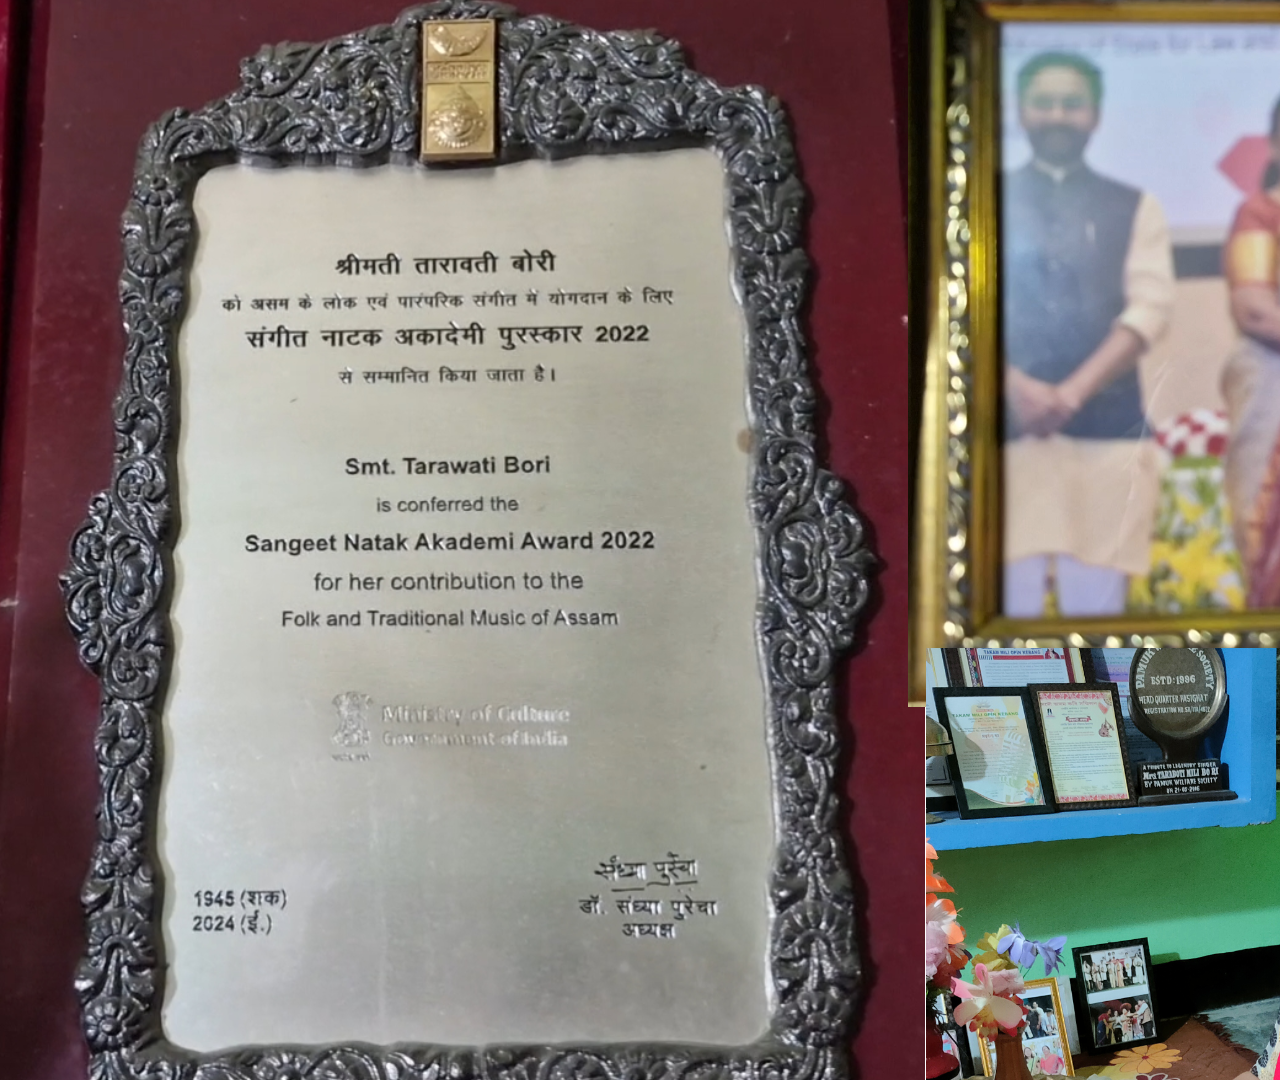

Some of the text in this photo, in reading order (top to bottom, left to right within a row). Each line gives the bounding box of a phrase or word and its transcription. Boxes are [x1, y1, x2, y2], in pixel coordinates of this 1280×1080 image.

[335, 248, 557, 275] श्रीमती तारावती बोरी
[222, 286, 674, 312] को असम के लोक एवं पारंपरिक संगीत में योगदान के लिए
[245, 321, 650, 350] संगीत नाटक अकादेमी पुरस्कार 2022
[339, 367, 353, 384] से
[363, 366, 430, 385] सम्मानित
[439, 365, 477, 383] किया
[487, 368, 525, 384] जाता
[345, 455, 550, 476] Smt. Tarawati Bori
[376, 496, 519, 513] is conferred the
[245, 530, 655, 556] Sangeet Natak Akademi Award 2022
[314, 571, 584, 591] for her contribution to the
[282, 608, 619, 627] Folk and Traditional Music of Assam
[1135, 648, 1157, 690] PAMUK
[1195, 649, 1215, 691] SOCIETY
[382, 704, 571, 726] Ministry of Culture
[382, 730, 569, 748] Government of India
[194, 889, 287, 910] 1945 (शक)
[616, 895, 663, 916] संध्या
[670, 895, 719, 920] पुरेचा
[192, 909, 272, 935] 2024 (ई.)
[622, 922, 677, 939] अध्यक्ष
